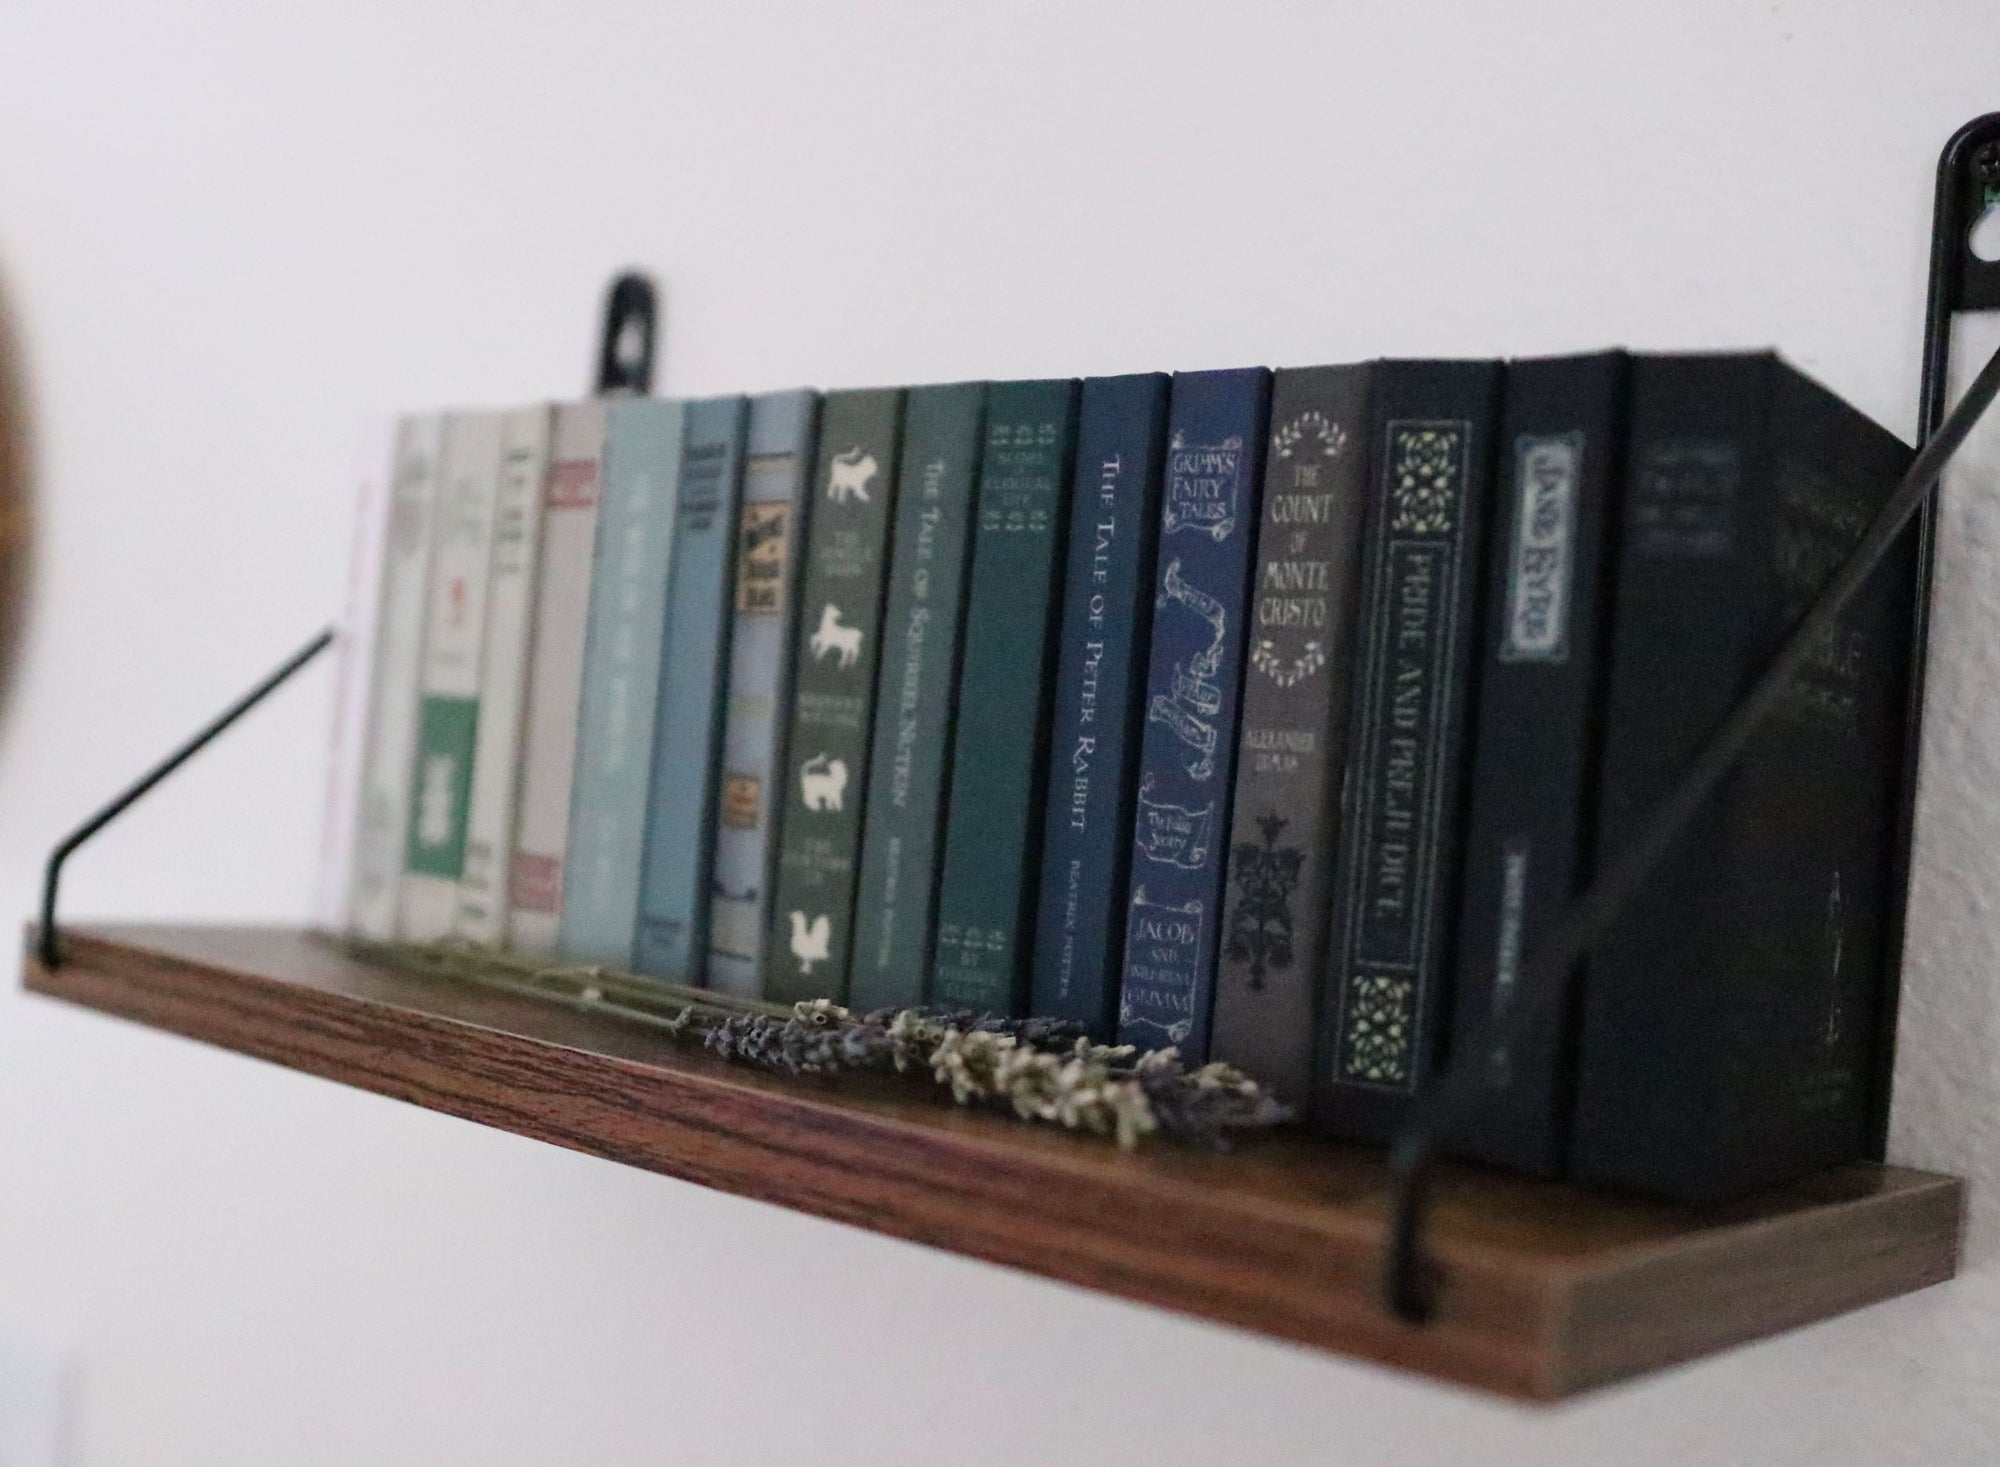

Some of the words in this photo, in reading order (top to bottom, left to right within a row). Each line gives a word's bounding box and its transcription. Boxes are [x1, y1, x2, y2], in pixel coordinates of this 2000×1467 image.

[1101, 453, 1120, 508] THE
[1172, 452, 1236, 475] GRIMM'S
[1293, 464, 1320, 488] THE
[1171, 477, 1224, 502] FAIRY
[1178, 501, 1227, 520] TALES
[1271, 493, 1333, 523] COUNT
[916, 508, 942, 560] TALE
[1092, 516, 1116, 584] TALE
[1290, 531, 1308, 554] OF
[1262, 561, 1330, 591] MONTE
[1088, 594, 1106, 630] OF
[1259, 597, 1327, 627] CRISTO
[1400, 553, 1432, 650] PRIDE
[1079, 641, 1105, 724] PETER
[1394, 660, 1422, 728] AND
[1071, 735, 1097, 833] RABBIT
[1066, 859, 1081, 929] BEATRIX
[1136, 917, 1195, 945] JACOB
[1058, 934, 1074, 999] POTTER
